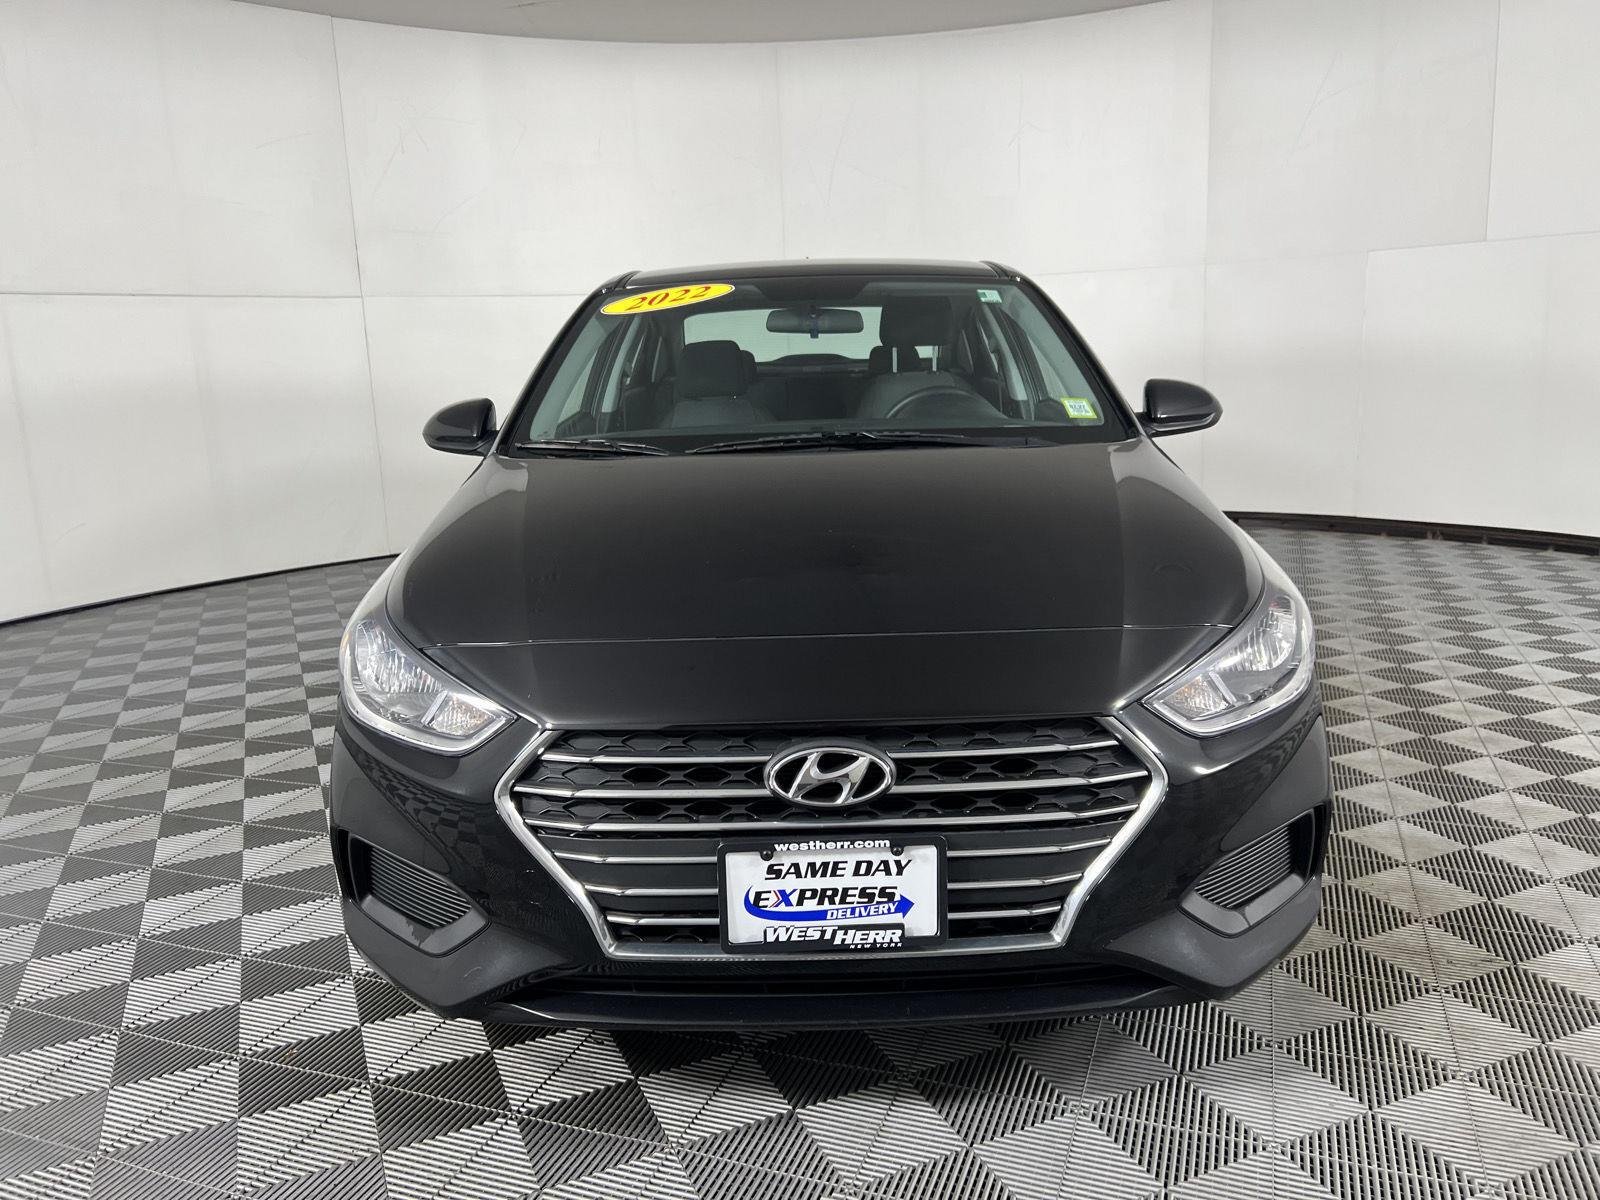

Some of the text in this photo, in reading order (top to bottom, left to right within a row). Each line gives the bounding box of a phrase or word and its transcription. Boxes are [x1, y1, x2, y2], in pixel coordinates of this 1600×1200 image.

[624, 286, 711, 311] 2022
[774, 839, 890, 851] westherr.com
[764, 859, 912, 880] SAME DAY
[752, 886, 898, 908] EXPRESS
[826, 902, 899, 920] DELIVERY
